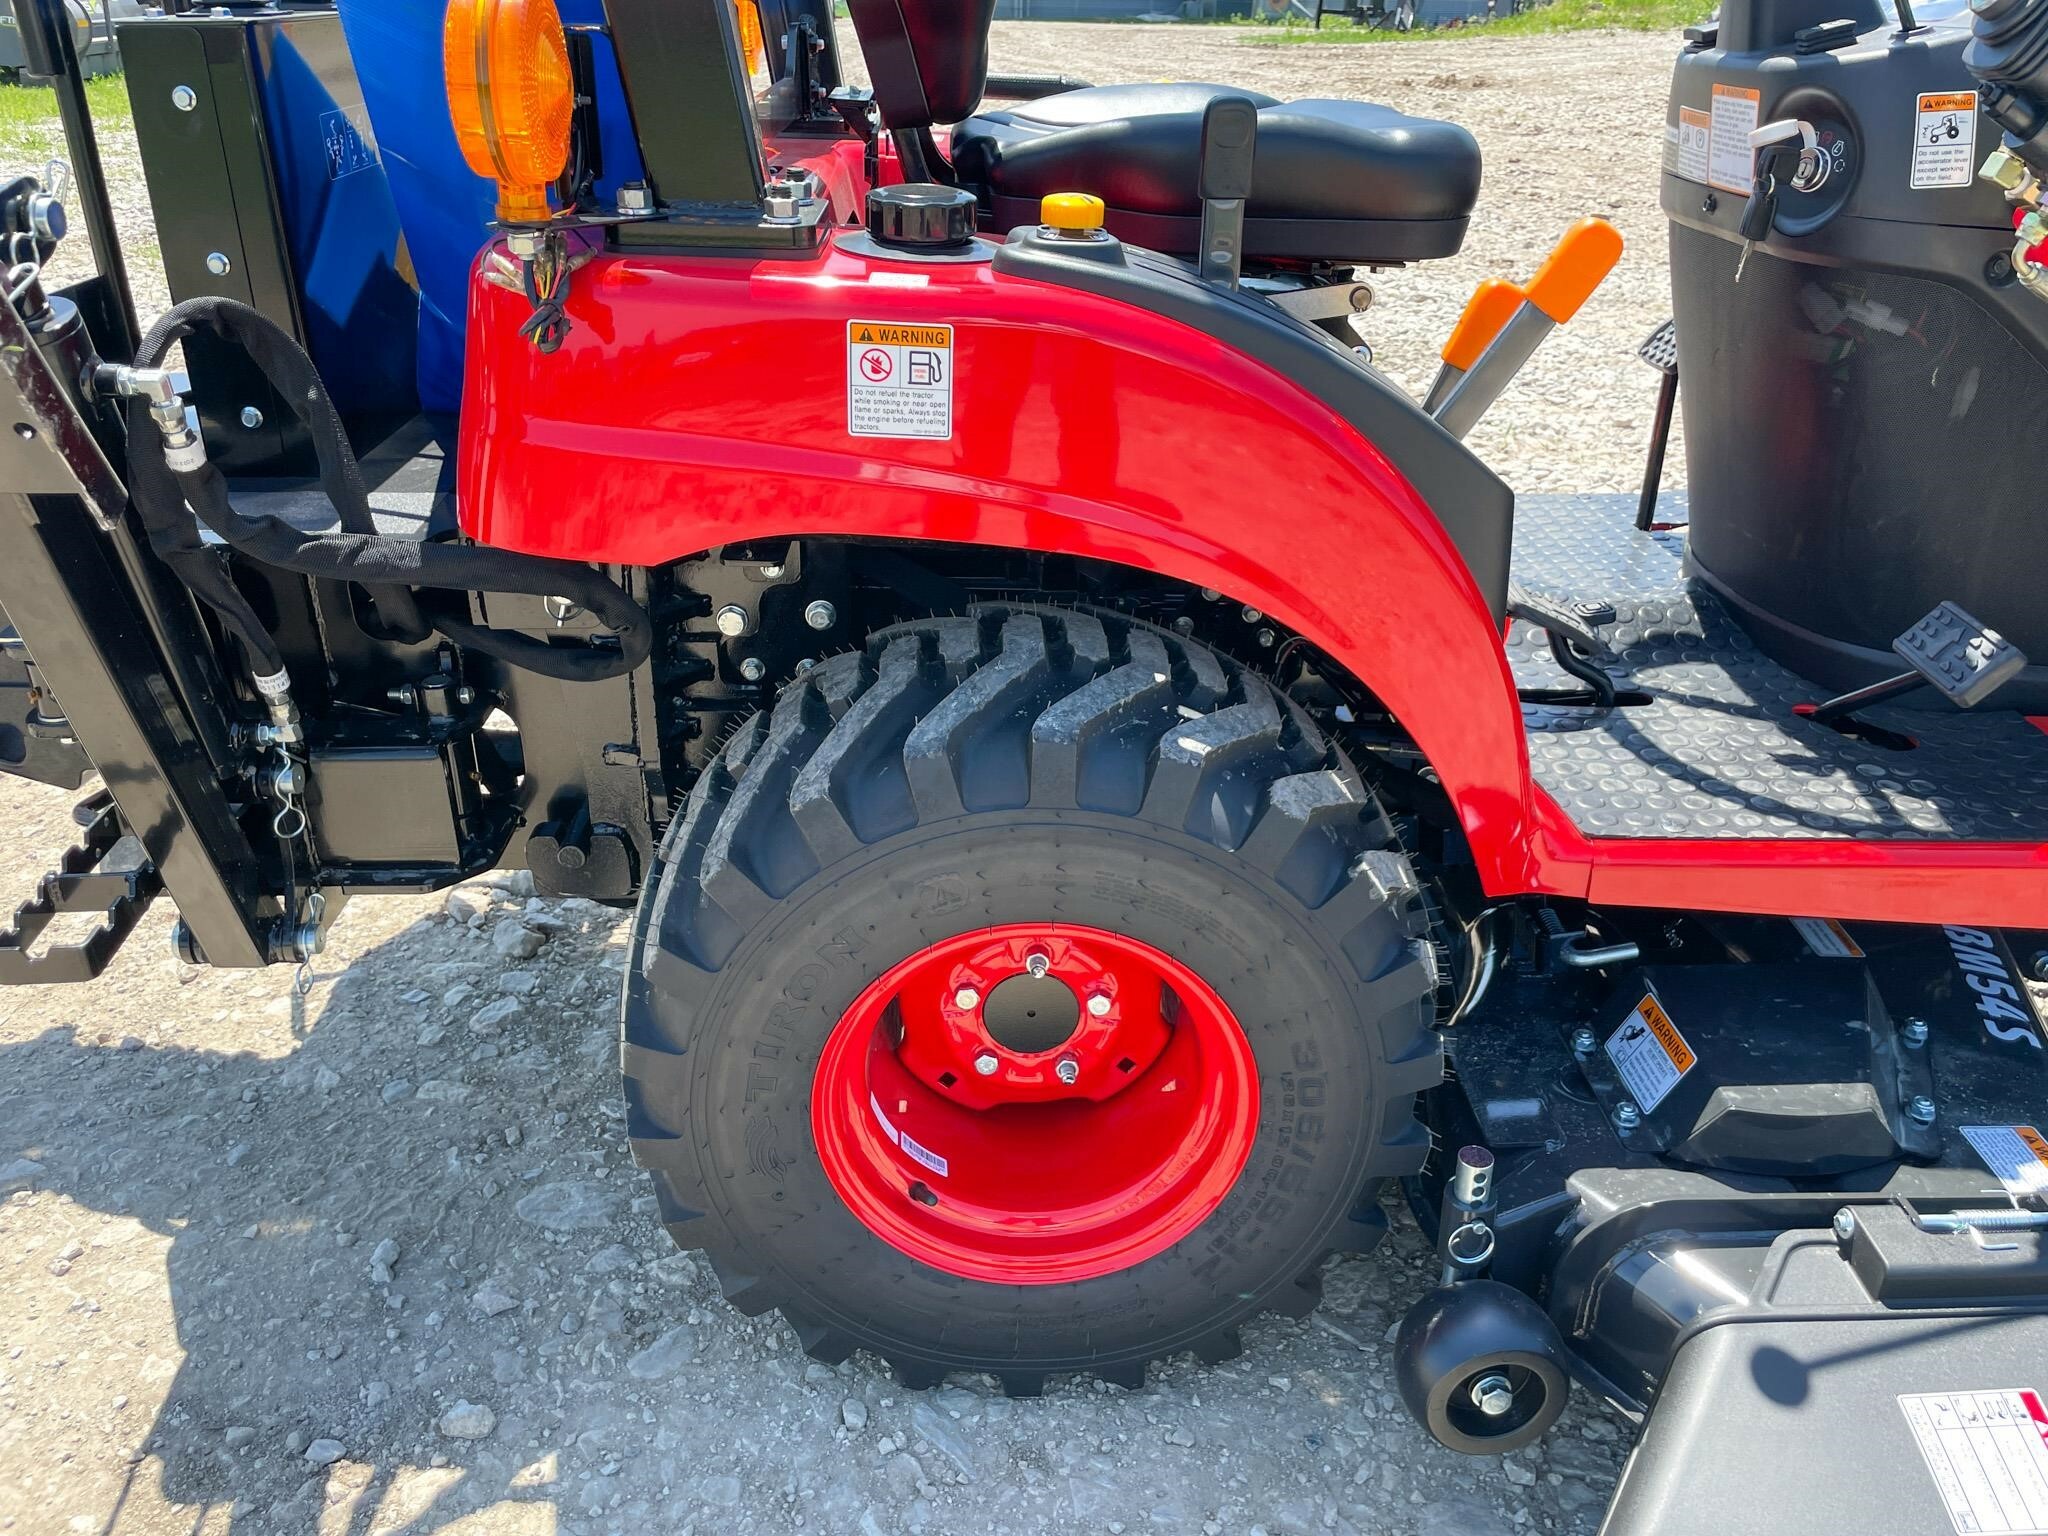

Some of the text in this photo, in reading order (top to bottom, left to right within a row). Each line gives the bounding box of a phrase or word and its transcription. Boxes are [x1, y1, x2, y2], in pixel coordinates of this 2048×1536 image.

[1934, 99, 1972, 108] WARNING
[879, 328, 945, 345] WARNING
[879, 389, 897, 397] refuel
[900, 390, 910, 398] the
[913, 391, 934, 399] tractor
[854, 397, 871, 405] while
[873, 398, 900, 407] smoking
[930, 401, 946, 409] open
[854, 405, 871, 413] flame
[883, 407, 905, 416] sparks.
[908, 408, 930, 417] Always
[932, 409, 946, 418] stop
[868, 415, 890, 424] engine
[893, 416, 914, 424] before
[917, 417, 946, 426] refueling
[854, 423, 880, 431] tractors.
[1942, 924, 2041, 1049] BM54S
[745, 925, 871, 1103] TIRON
[1651, 1014, 1687, 1065] WARNING
